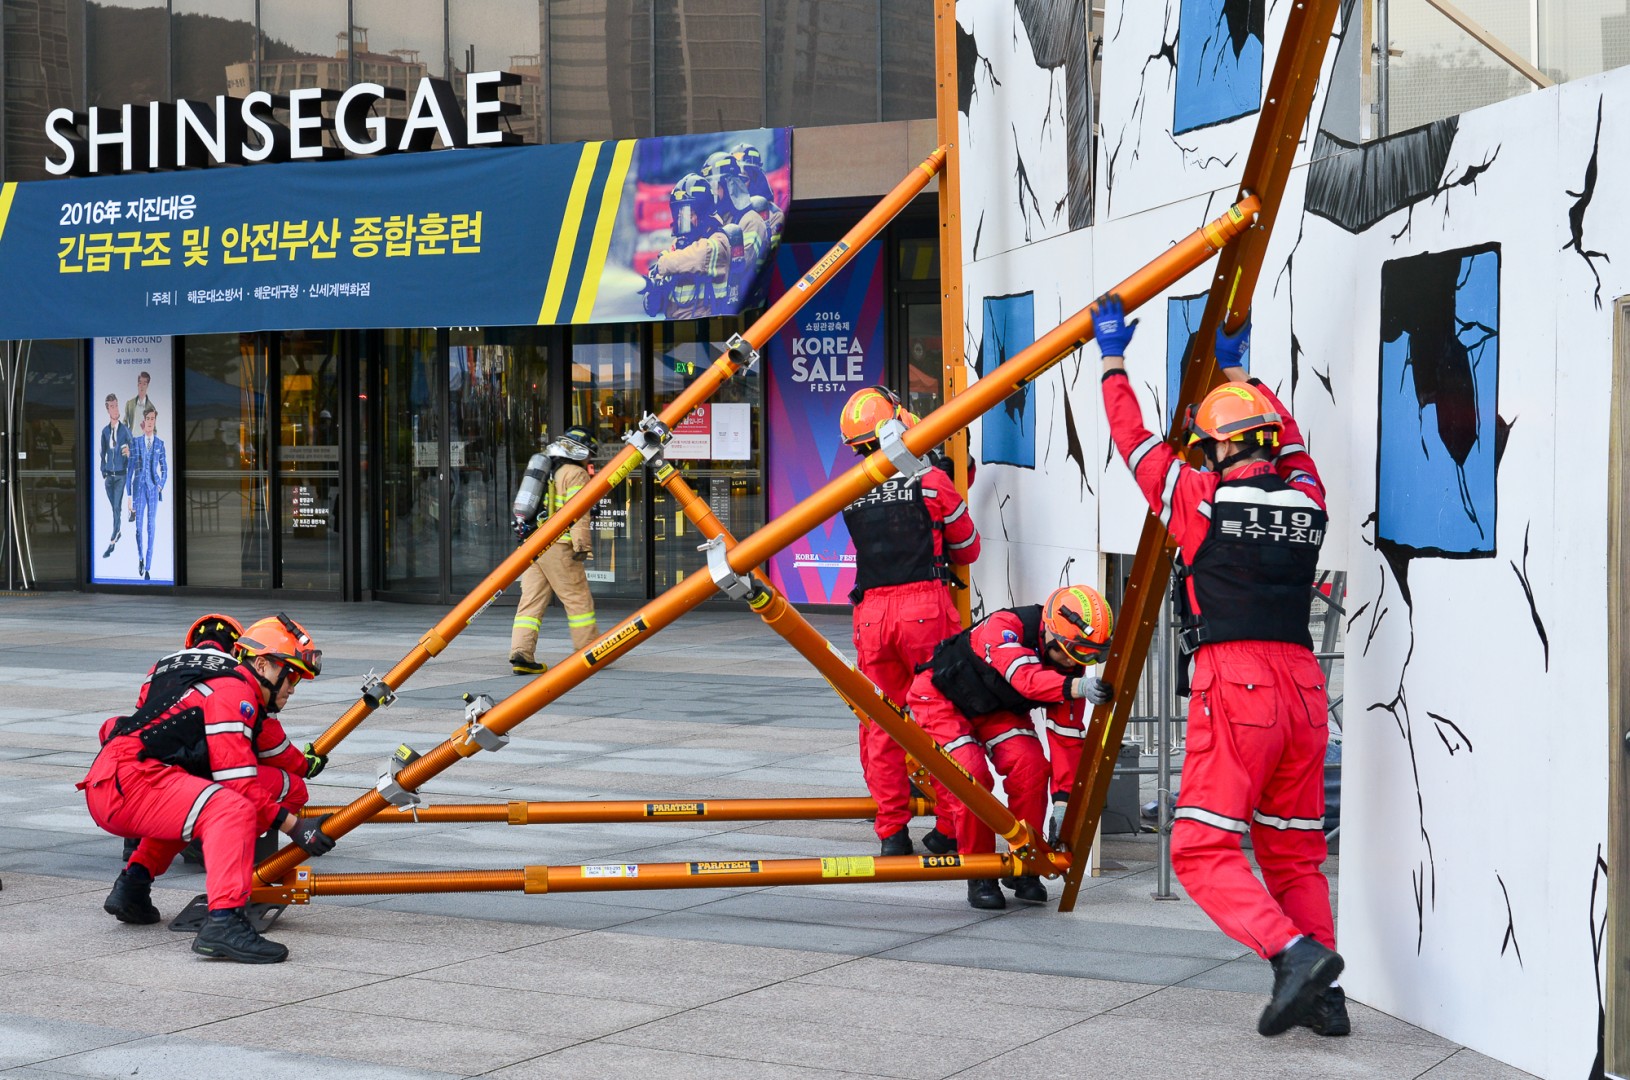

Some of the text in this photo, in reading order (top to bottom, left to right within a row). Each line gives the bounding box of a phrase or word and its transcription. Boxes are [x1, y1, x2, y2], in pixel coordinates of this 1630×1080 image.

[45, 70, 503, 175] SHINSEGAE
[59, 194, 197, 226] 2016年 지진대응
[57, 211, 482, 273] 긴급구조 및 안전부산 종합훈련
[151, 282, 371, 305] 주최 해운대소방서 해운대구청 신세계백화점
[815, 311, 841, 321] 2016
[805, 322, 850, 331] 쇼핑관광축제
[104, 336, 162, 345] NEW GROUND
[792, 336, 864, 355] KOREA
[791, 355, 864, 383] SALE
[810, 383, 846, 392] FESTA
[1243, 507, 1312, 528] 119
[1220, 520, 1323, 546] 특수구조대
[795, 553, 820, 561] KOREA
[839, 554, 857, 562] FEST
[591, 620, 638, 657] PARATECH
[653, 803, 698, 812] PARATECH
[697, 861, 752, 870] PARATECH
[928, 856, 955, 866] 610
